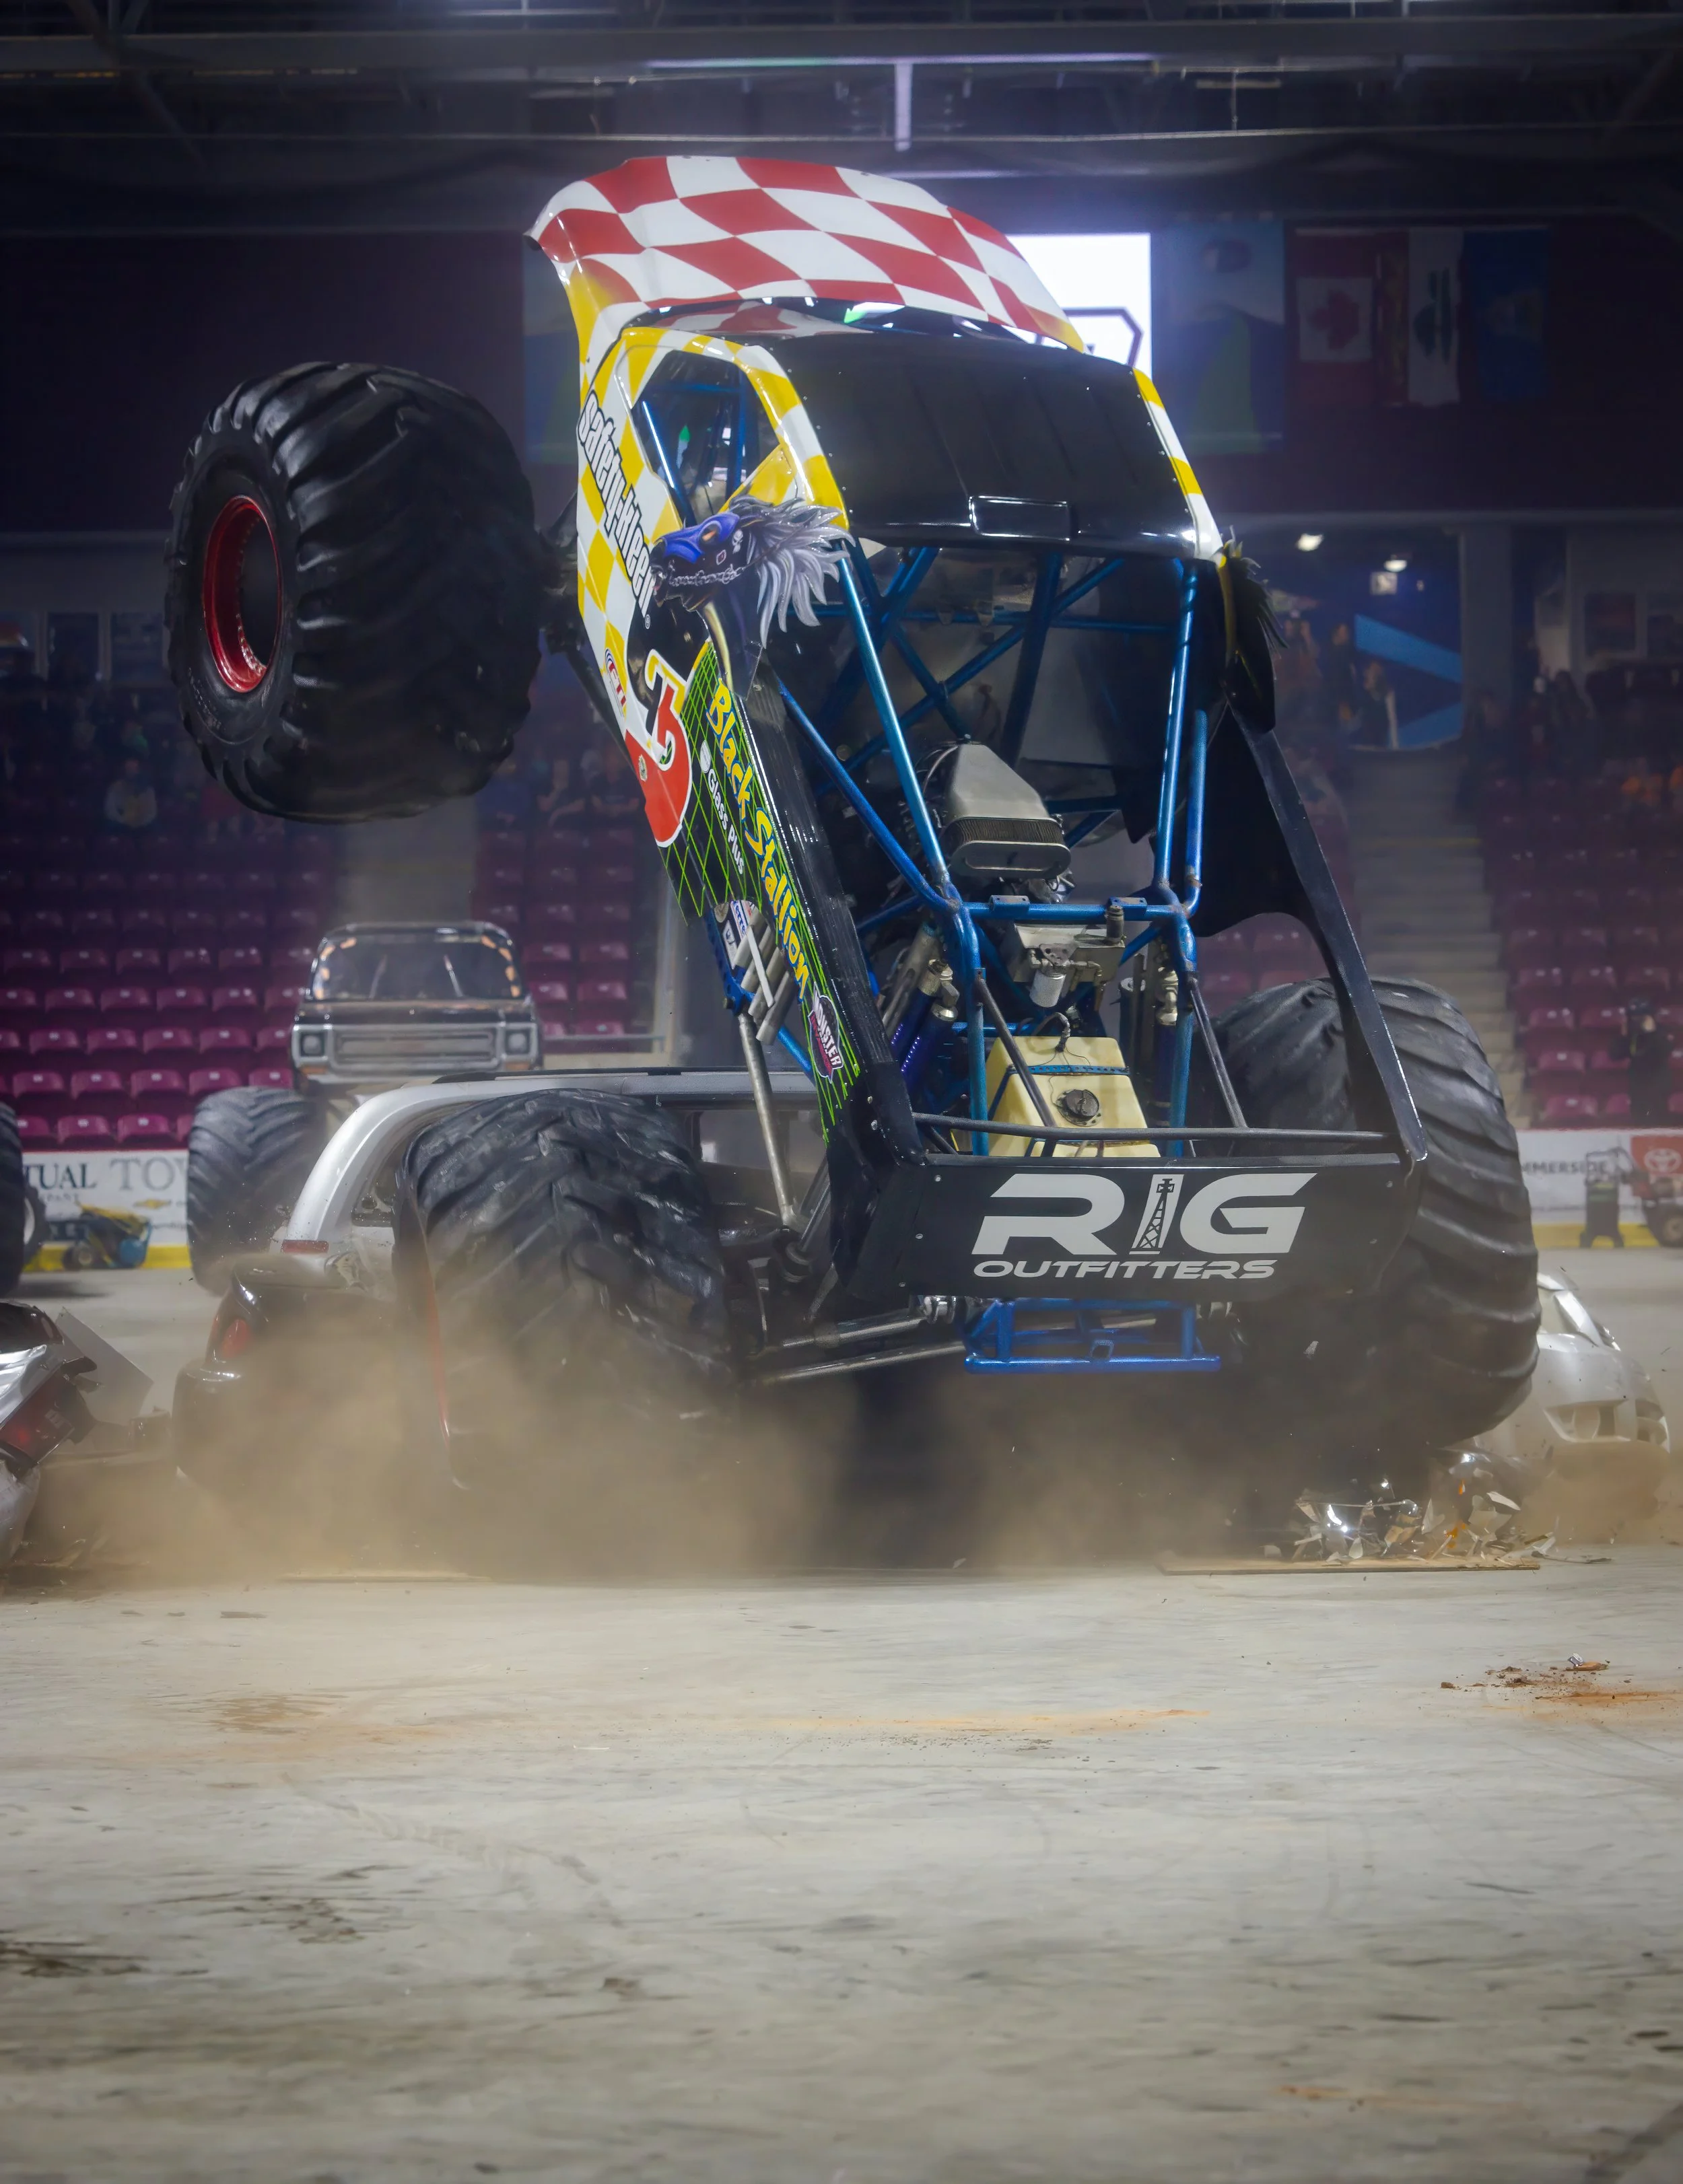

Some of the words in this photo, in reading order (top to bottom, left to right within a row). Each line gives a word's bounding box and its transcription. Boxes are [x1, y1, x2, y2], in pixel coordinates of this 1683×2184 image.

[706, 678, 753, 822] Black
[745, 808, 809, 1002] Stallion
[708, 769, 728, 830] Glass
[728, 824, 745, 874] Plus
[971, 1173, 1317, 1255] RIG
[973, 1259, 1278, 1279] OUTFITTERS
